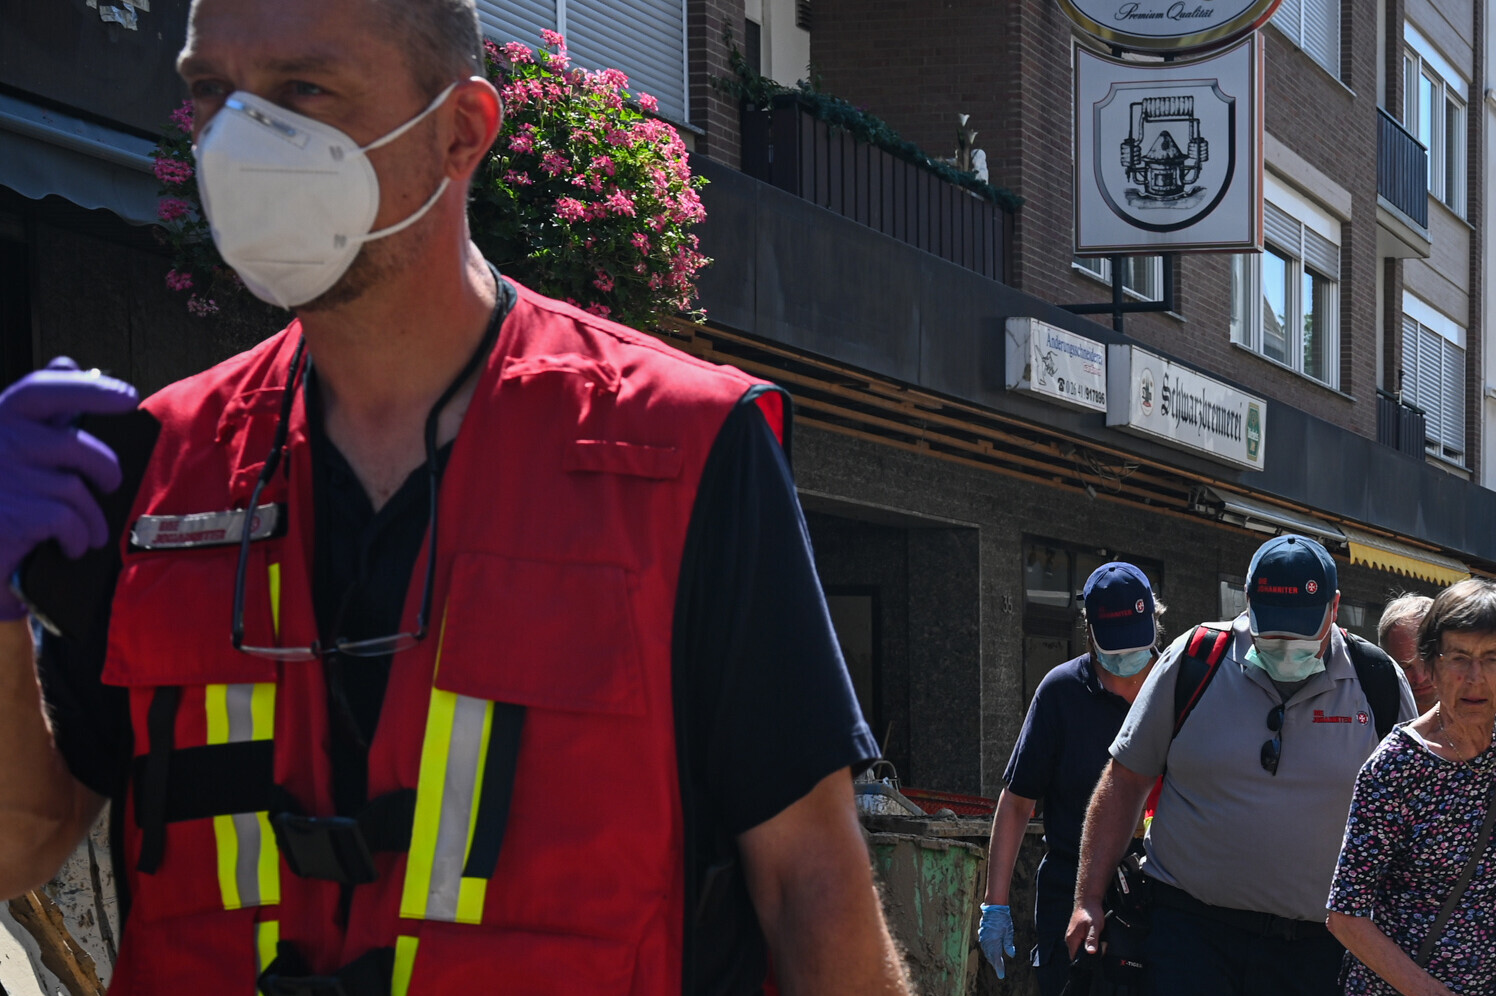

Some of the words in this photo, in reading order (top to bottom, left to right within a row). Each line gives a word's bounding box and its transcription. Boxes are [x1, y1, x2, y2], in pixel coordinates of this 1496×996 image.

[1114, 2, 1164, 20] Premium
[1166, 1, 1214, 20] Qualität
[1161, 372, 1242, 442] Schwarzbrennerei
[1257, 585, 1299, 594] JOHANNITER
